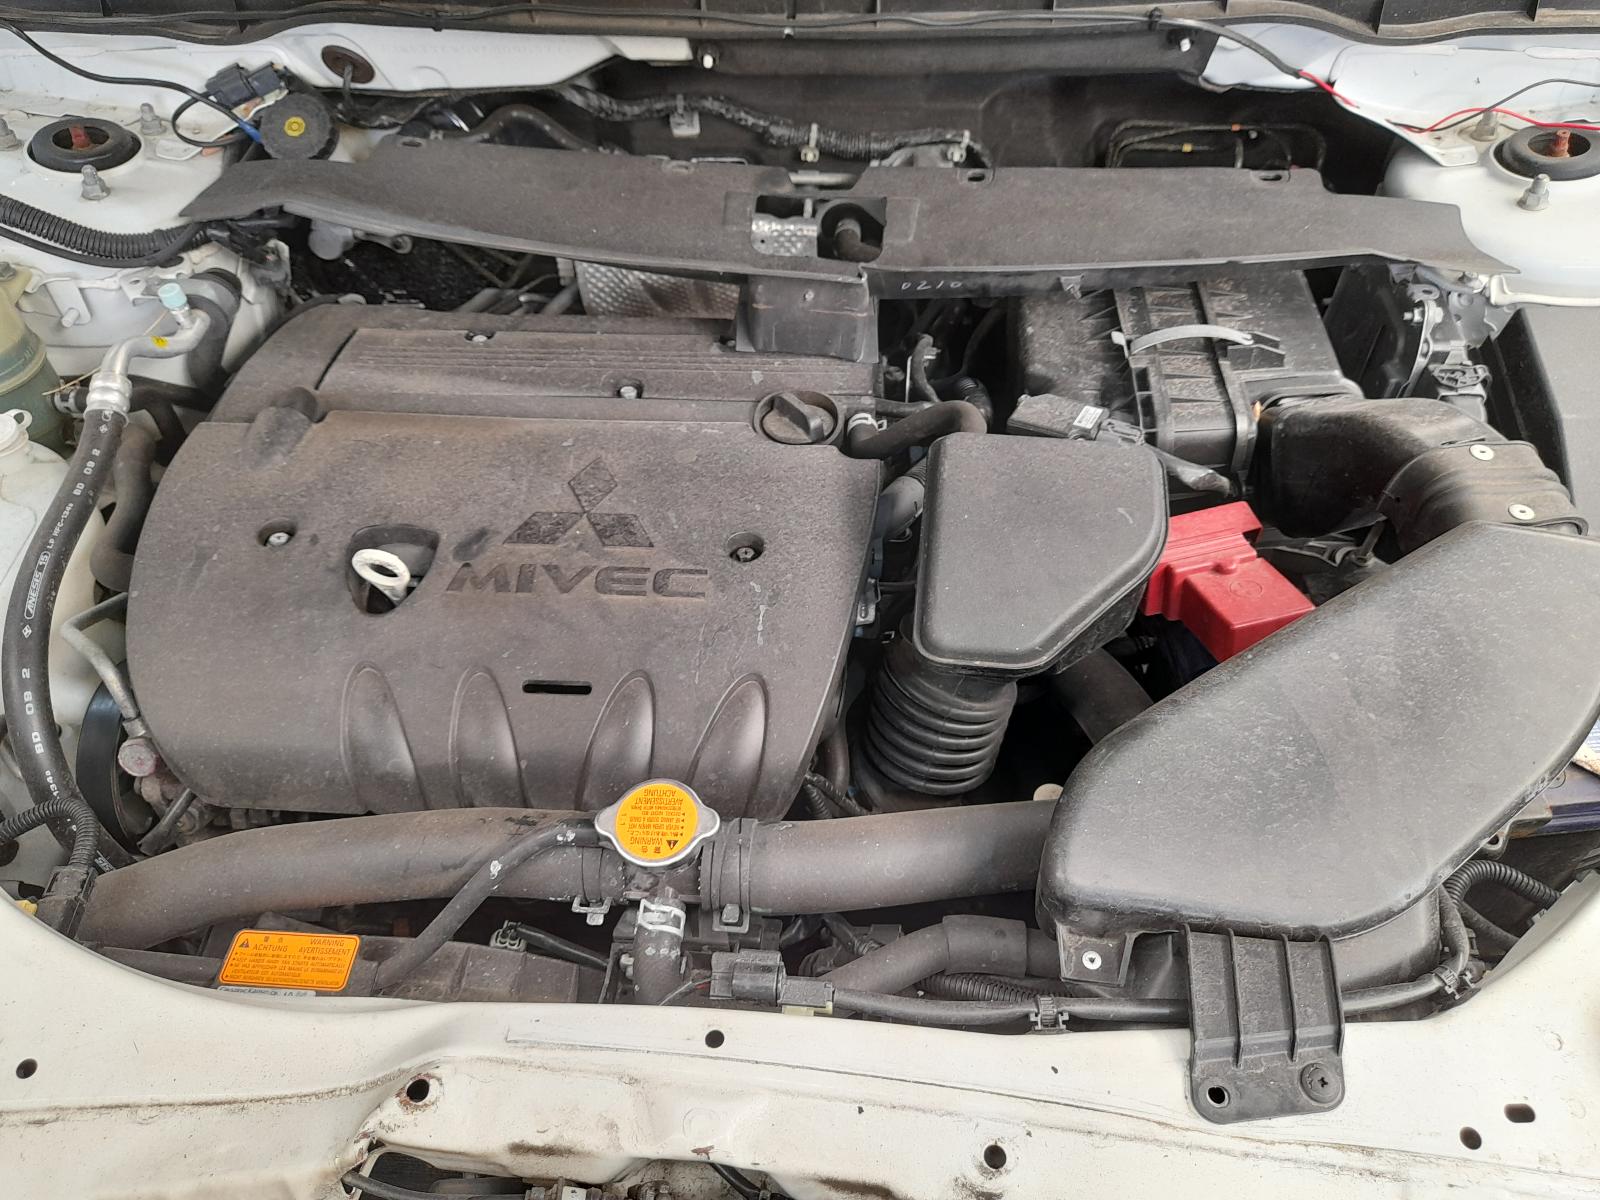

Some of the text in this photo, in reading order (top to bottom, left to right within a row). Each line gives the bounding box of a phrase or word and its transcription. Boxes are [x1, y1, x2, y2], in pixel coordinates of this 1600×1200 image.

[446, 562, 709, 600] MIVEC
[21, 667, 32, 679] 2
[24, 690, 35, 716] 09
[31, 731, 45, 755] BD
[643, 789, 676, 797] ACHTUNG
[635, 797, 683, 805] AVERTISSEMENT
[630, 837, 663, 845] WARNING
[310, 938, 345, 947] WARNING
[253, 944, 289, 952] ACHTUNG
[298, 946, 352, 956] AVERTISSEMENT
